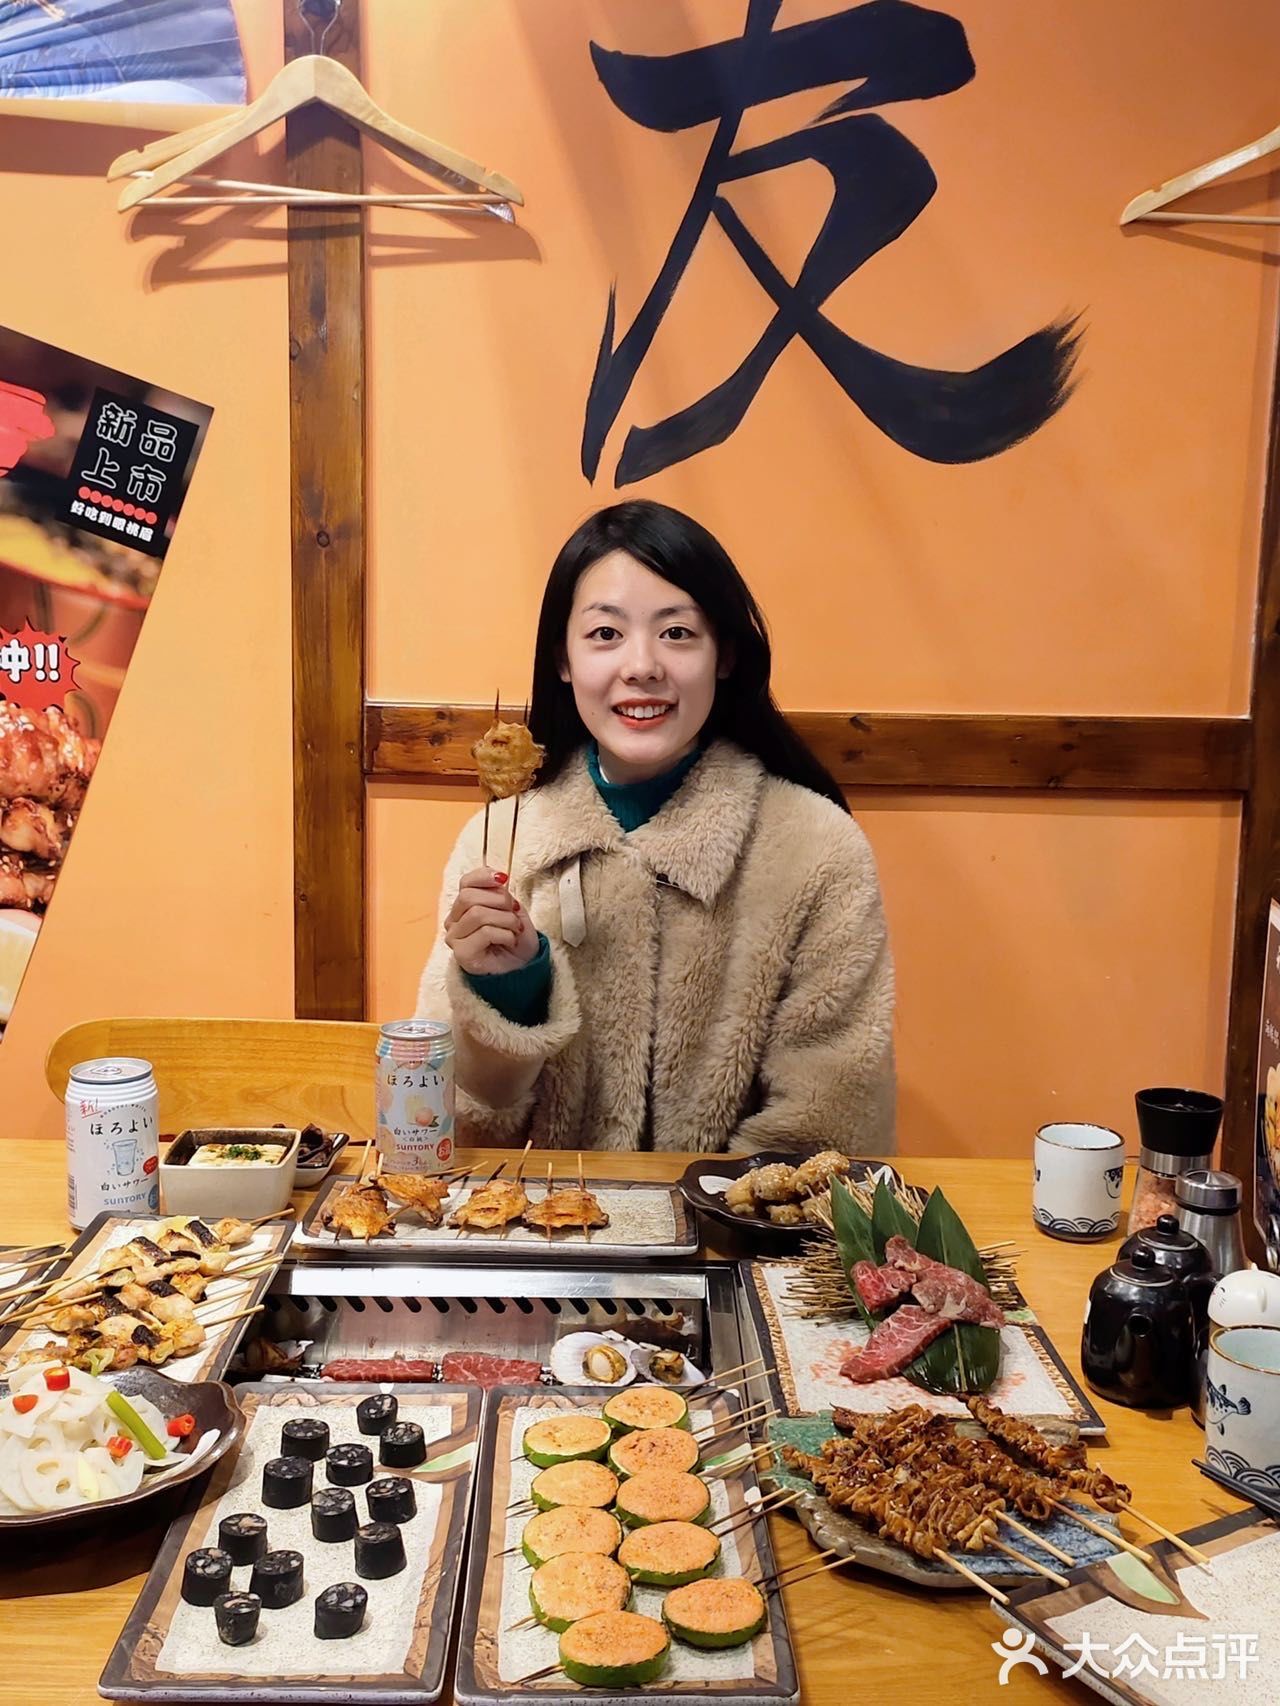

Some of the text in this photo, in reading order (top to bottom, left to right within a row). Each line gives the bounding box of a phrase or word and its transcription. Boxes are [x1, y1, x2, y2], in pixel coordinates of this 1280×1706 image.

[582, 0, 1088, 487] 友
[97, 402, 177, 462] 新品
[81, 447, 167, 503] 上市
[387, 1074, 444, 1088] ほろよい
[90, 1116, 153, 1136] ほろよい
[396, 1143, 435, 1152] SUNTORY
[101, 1178, 149, 1192] 白いサワー
[103, 1192, 146, 1206] SUNTORY
